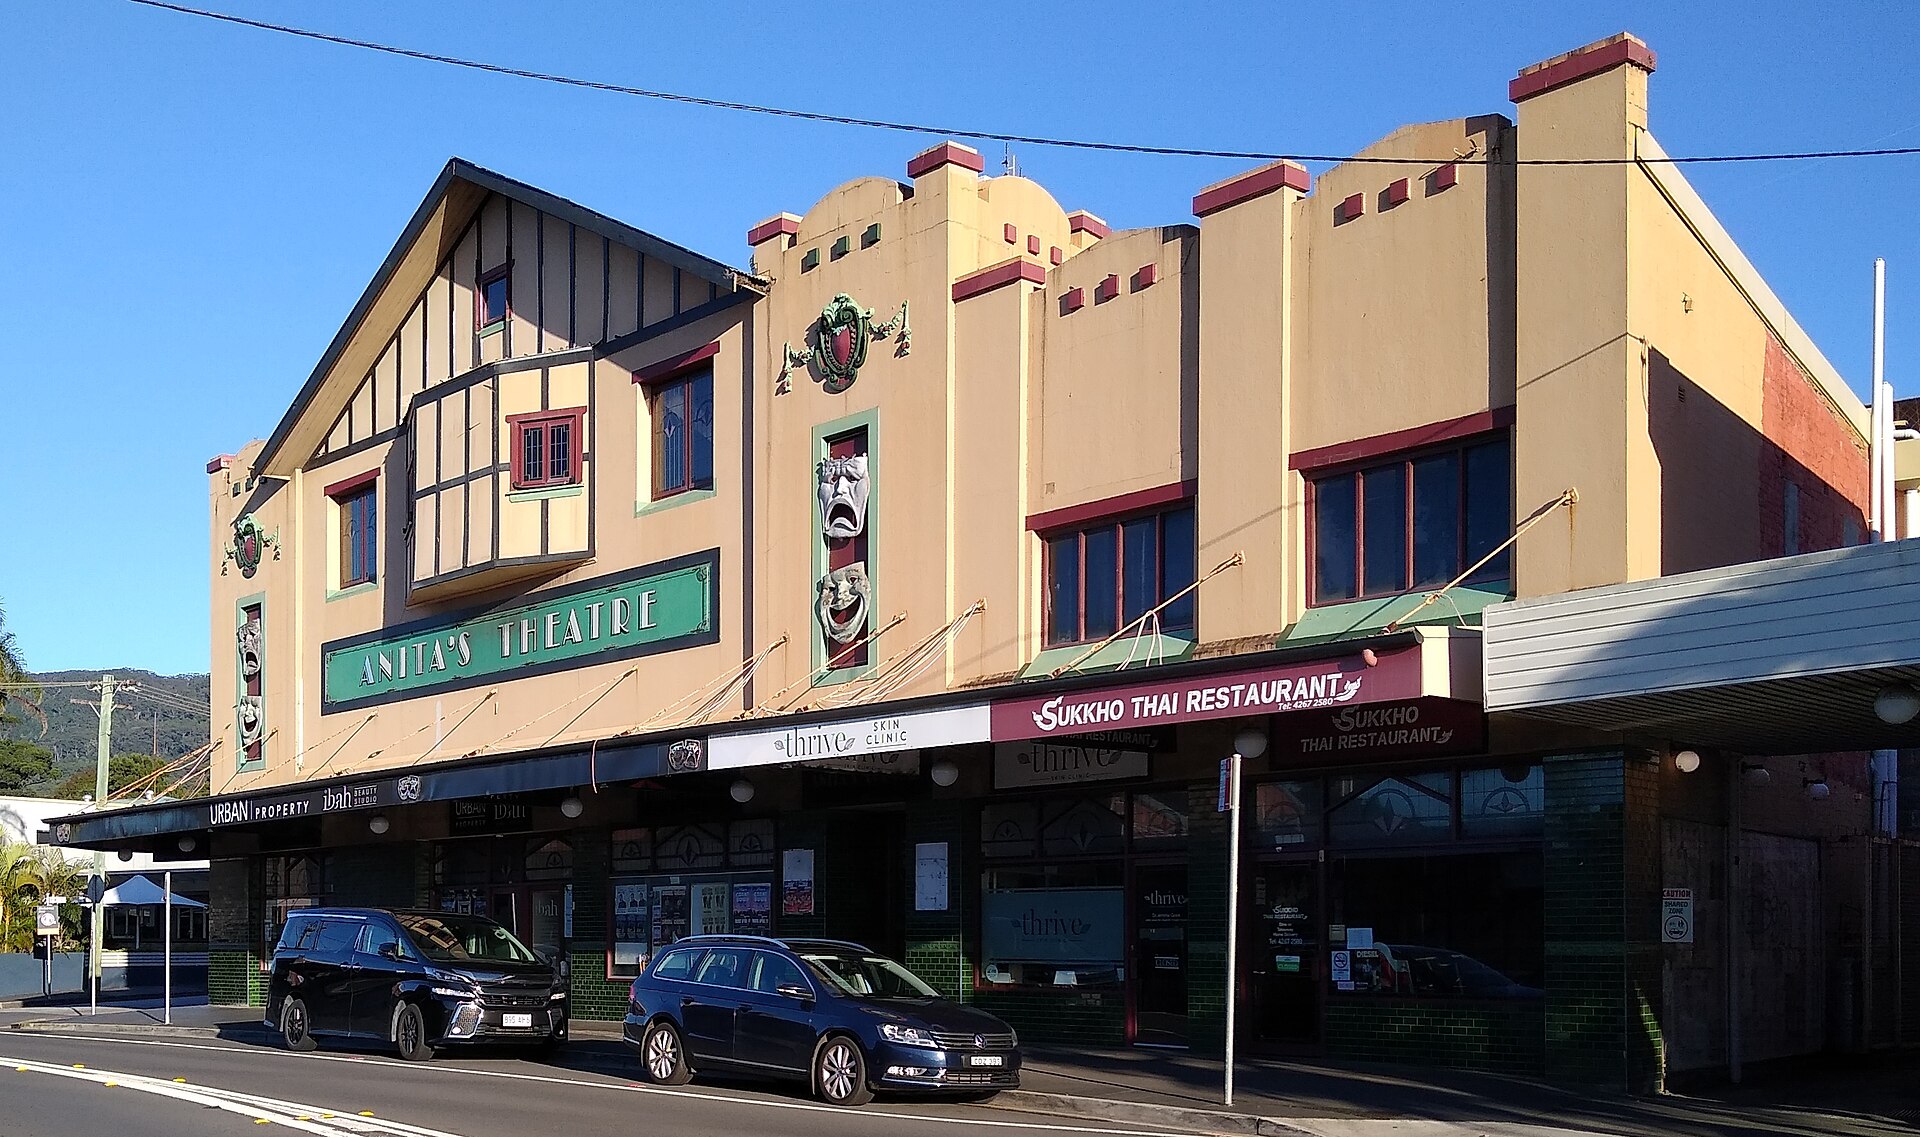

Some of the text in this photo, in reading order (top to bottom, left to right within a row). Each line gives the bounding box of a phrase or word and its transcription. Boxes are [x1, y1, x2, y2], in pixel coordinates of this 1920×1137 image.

[358, 590, 657, 687] ANITA'S THEATRE
[1031, 672, 1343, 731] SUKKHO THAI RESTAURANT
[1277, 698, 1334, 711] Tel: 4267 2580
[873, 719, 900, 732] SKIN
[1331, 705, 1419, 731] SUKKHO
[784, 725, 847, 758] thrive
[866, 731, 907, 745] CLINIC
[1300, 726, 1441, 752] THAI RESTAURANT
[322, 785, 352, 811] ibah
[353, 787, 377, 797] BEAUTY
[353, 795, 377, 805] STUDIO
[209, 799, 309, 825] URBAN PROPERTY
[1150, 889, 1184, 905] thrive
[1022, 908, 1082, 935] thrive
